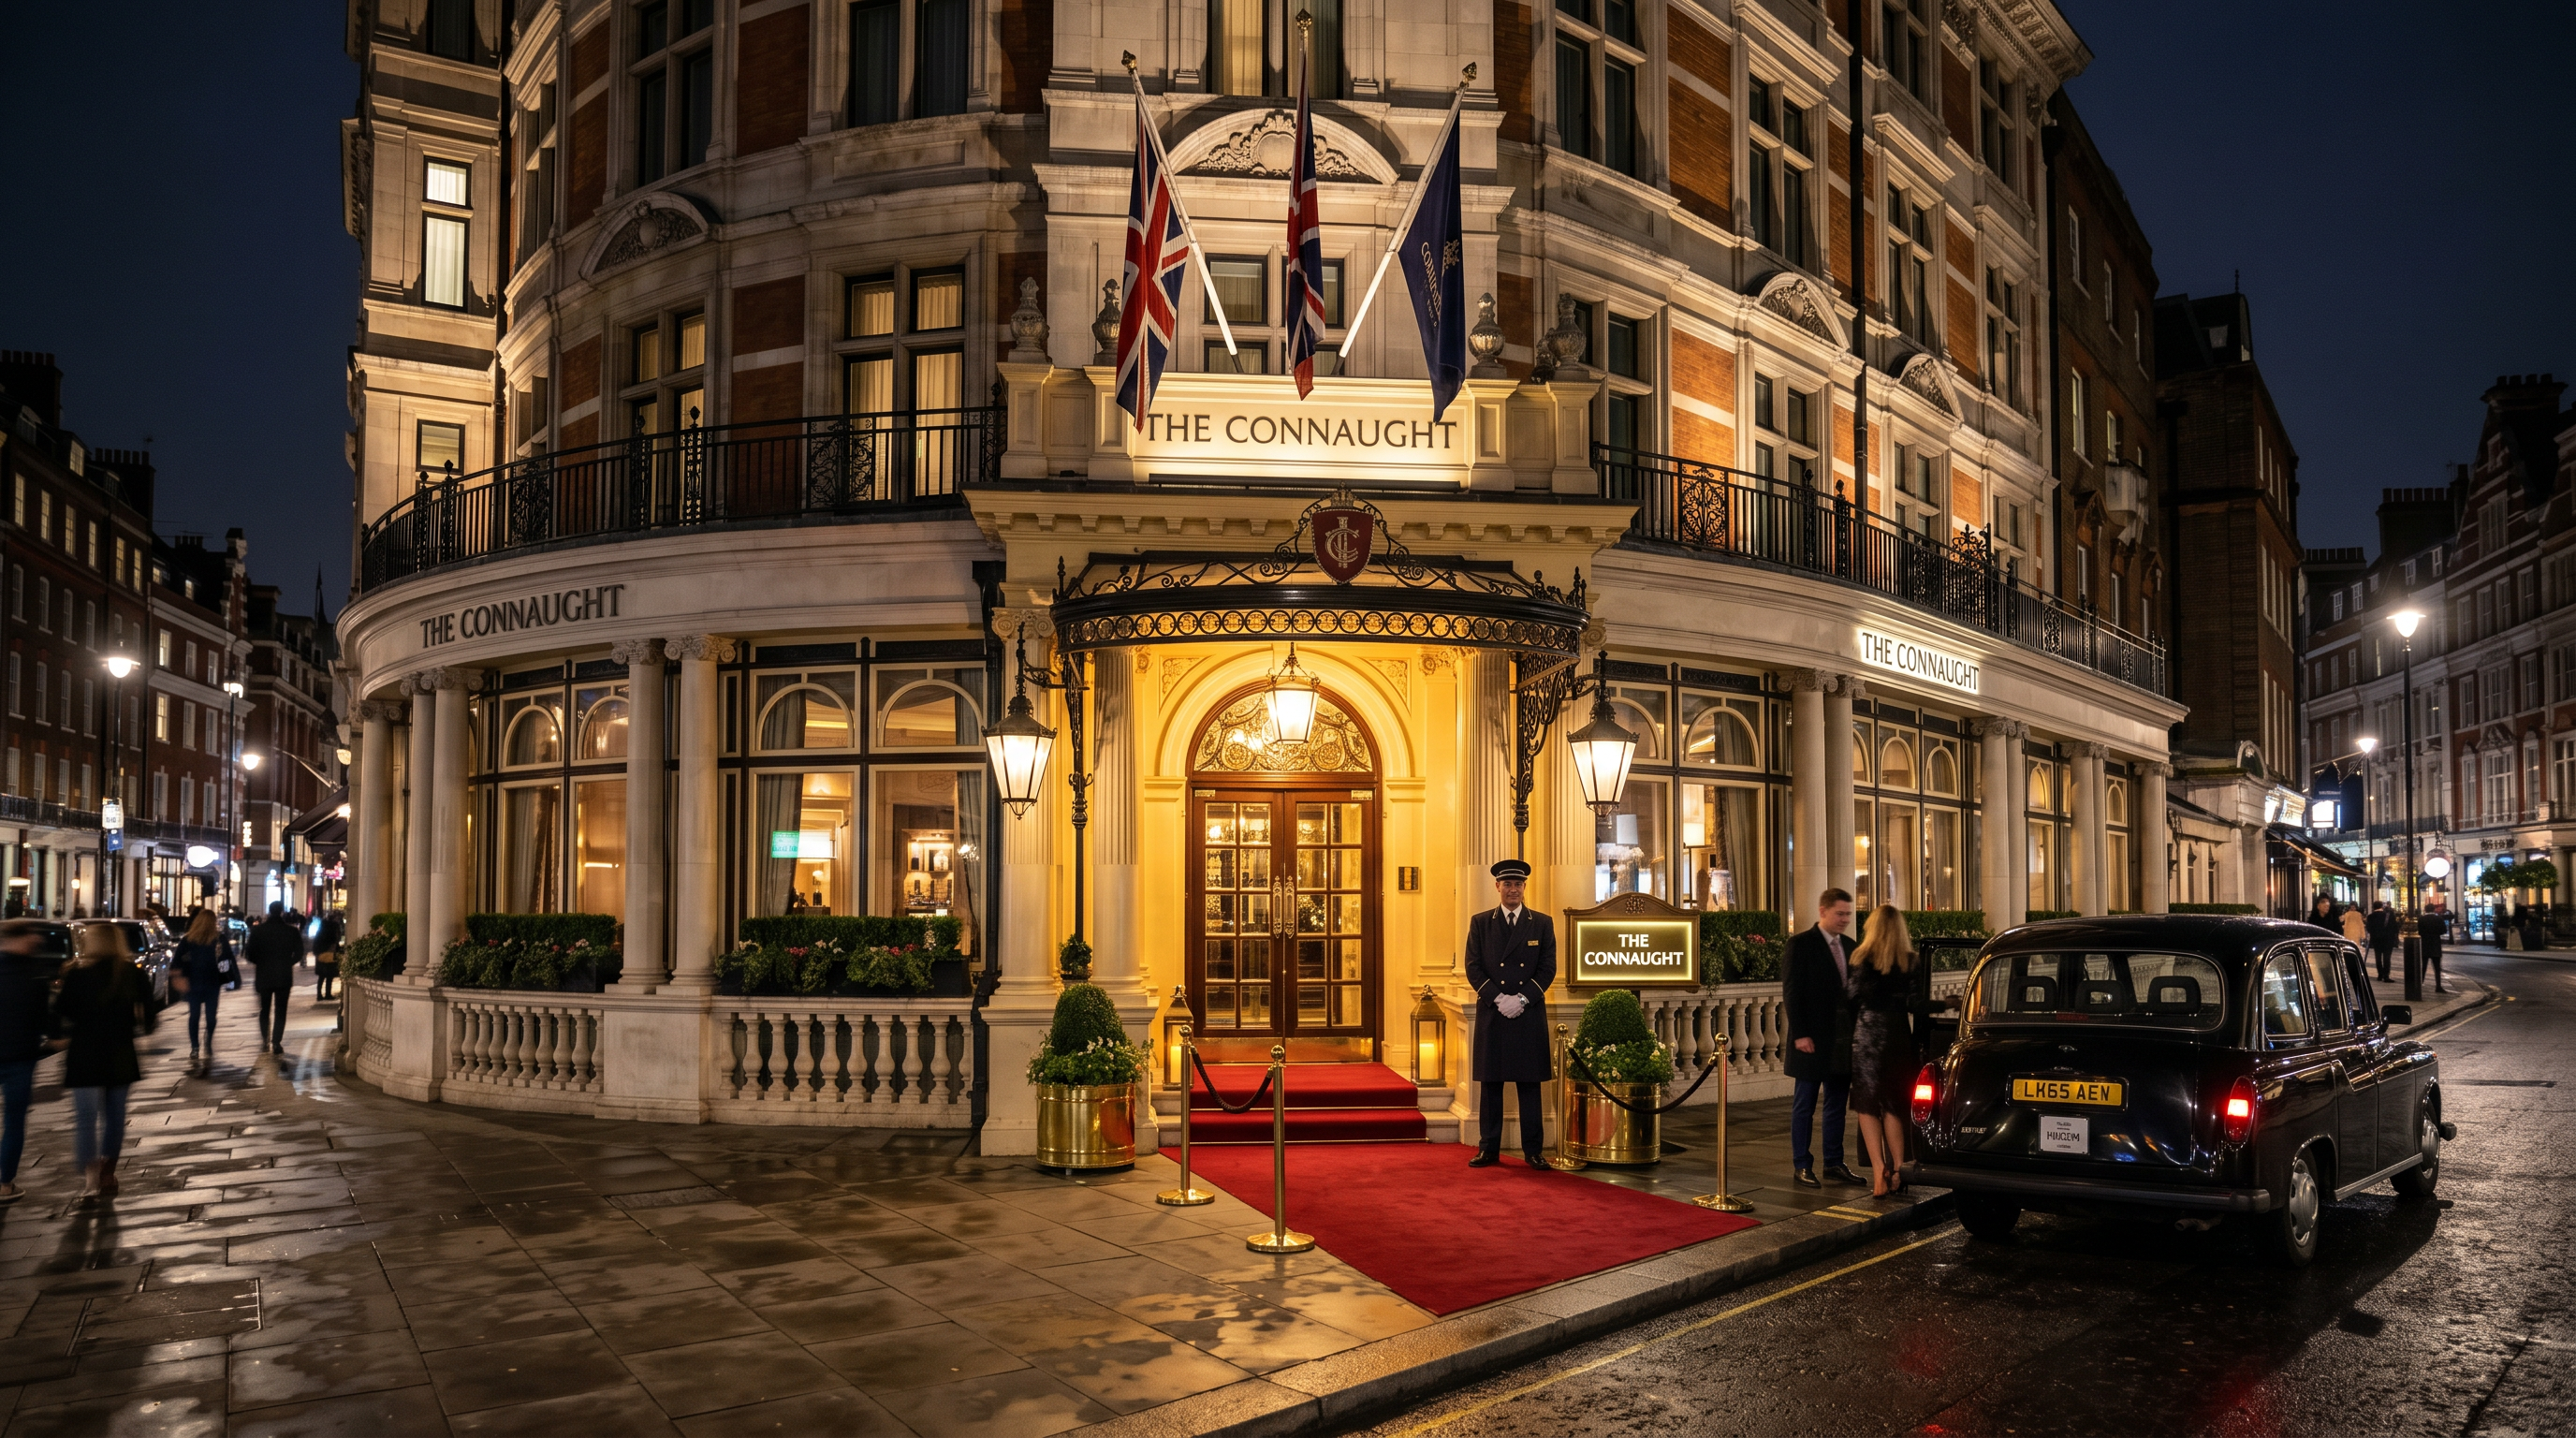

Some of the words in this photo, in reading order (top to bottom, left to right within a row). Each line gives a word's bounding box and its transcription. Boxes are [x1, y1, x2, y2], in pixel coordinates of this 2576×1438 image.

[1148, 413, 1211, 443] THE
[1225, 416, 1457, 449] CONNAUGHT
[420, 612, 455, 649] THE
[460, 583, 624, 639] CONNAUGHT
[1862, 632, 1893, 666] THE
[1896, 643, 1980, 690] CONNAUGHT
[1617, 933, 1649, 948] THE
[1584, 951, 1684, 966] CONNAUGHT
[2024, 1081, 2071, 1100] LK65
[2076, 1083, 2110, 1102] AEN
